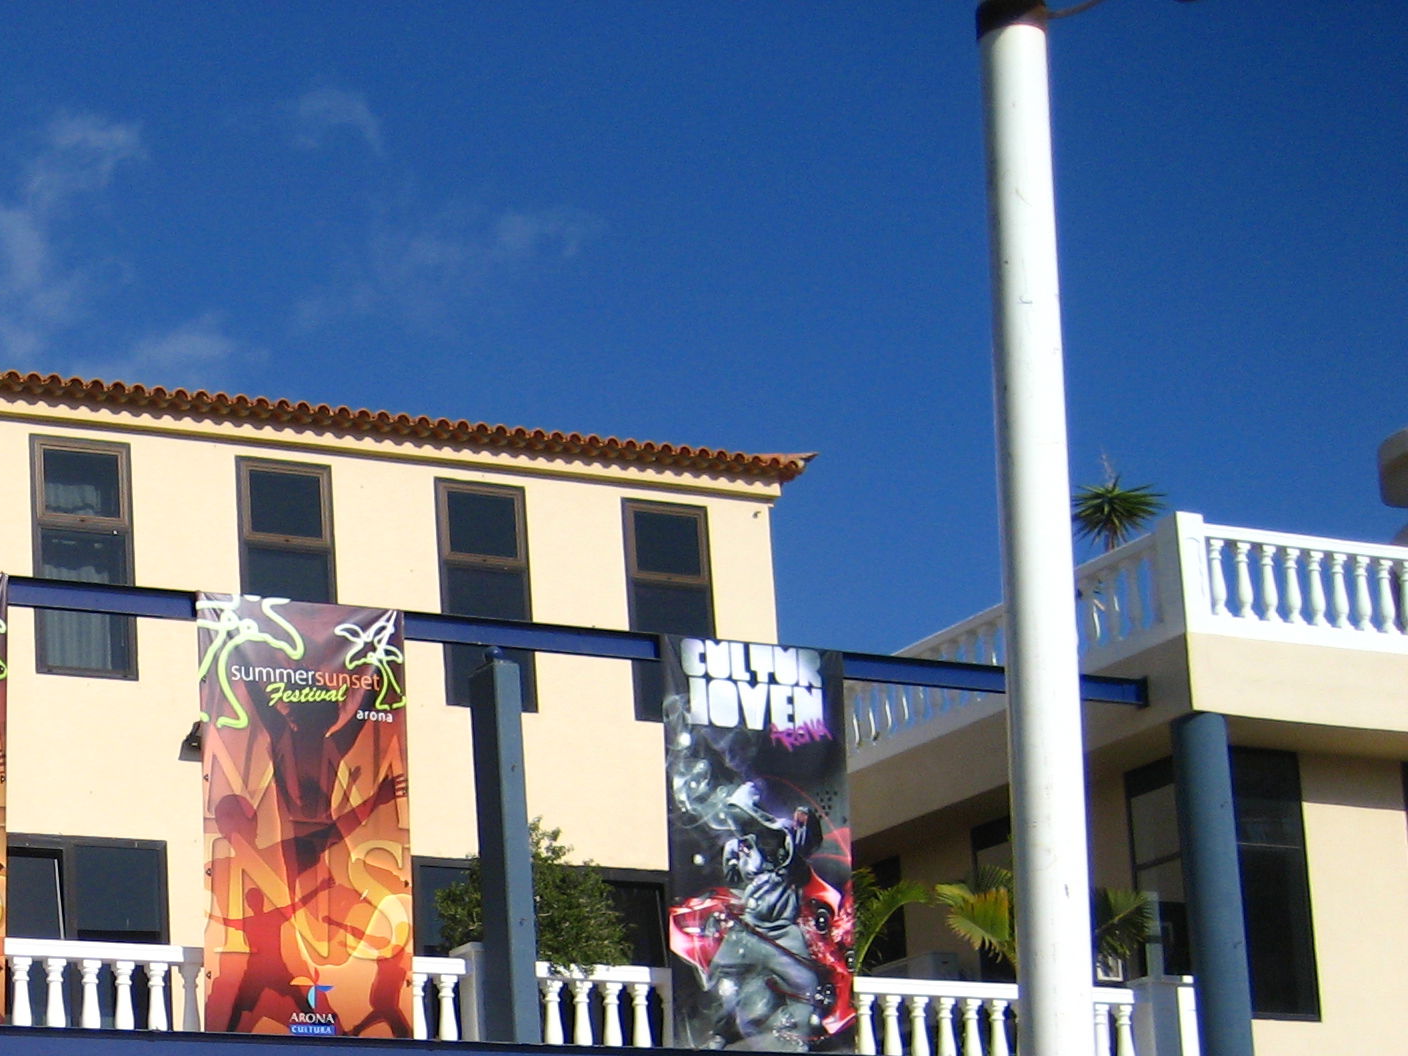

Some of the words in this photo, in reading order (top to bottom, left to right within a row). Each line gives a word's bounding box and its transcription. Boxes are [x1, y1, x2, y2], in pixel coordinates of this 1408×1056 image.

[680, 638, 822, 688] CULTUR
[265, 682, 349, 706] Festival
[356, 709, 393, 723] arona
[289, 1012, 335, 1024] ARONA
[291, 1025, 332, 1034] CULTURA
